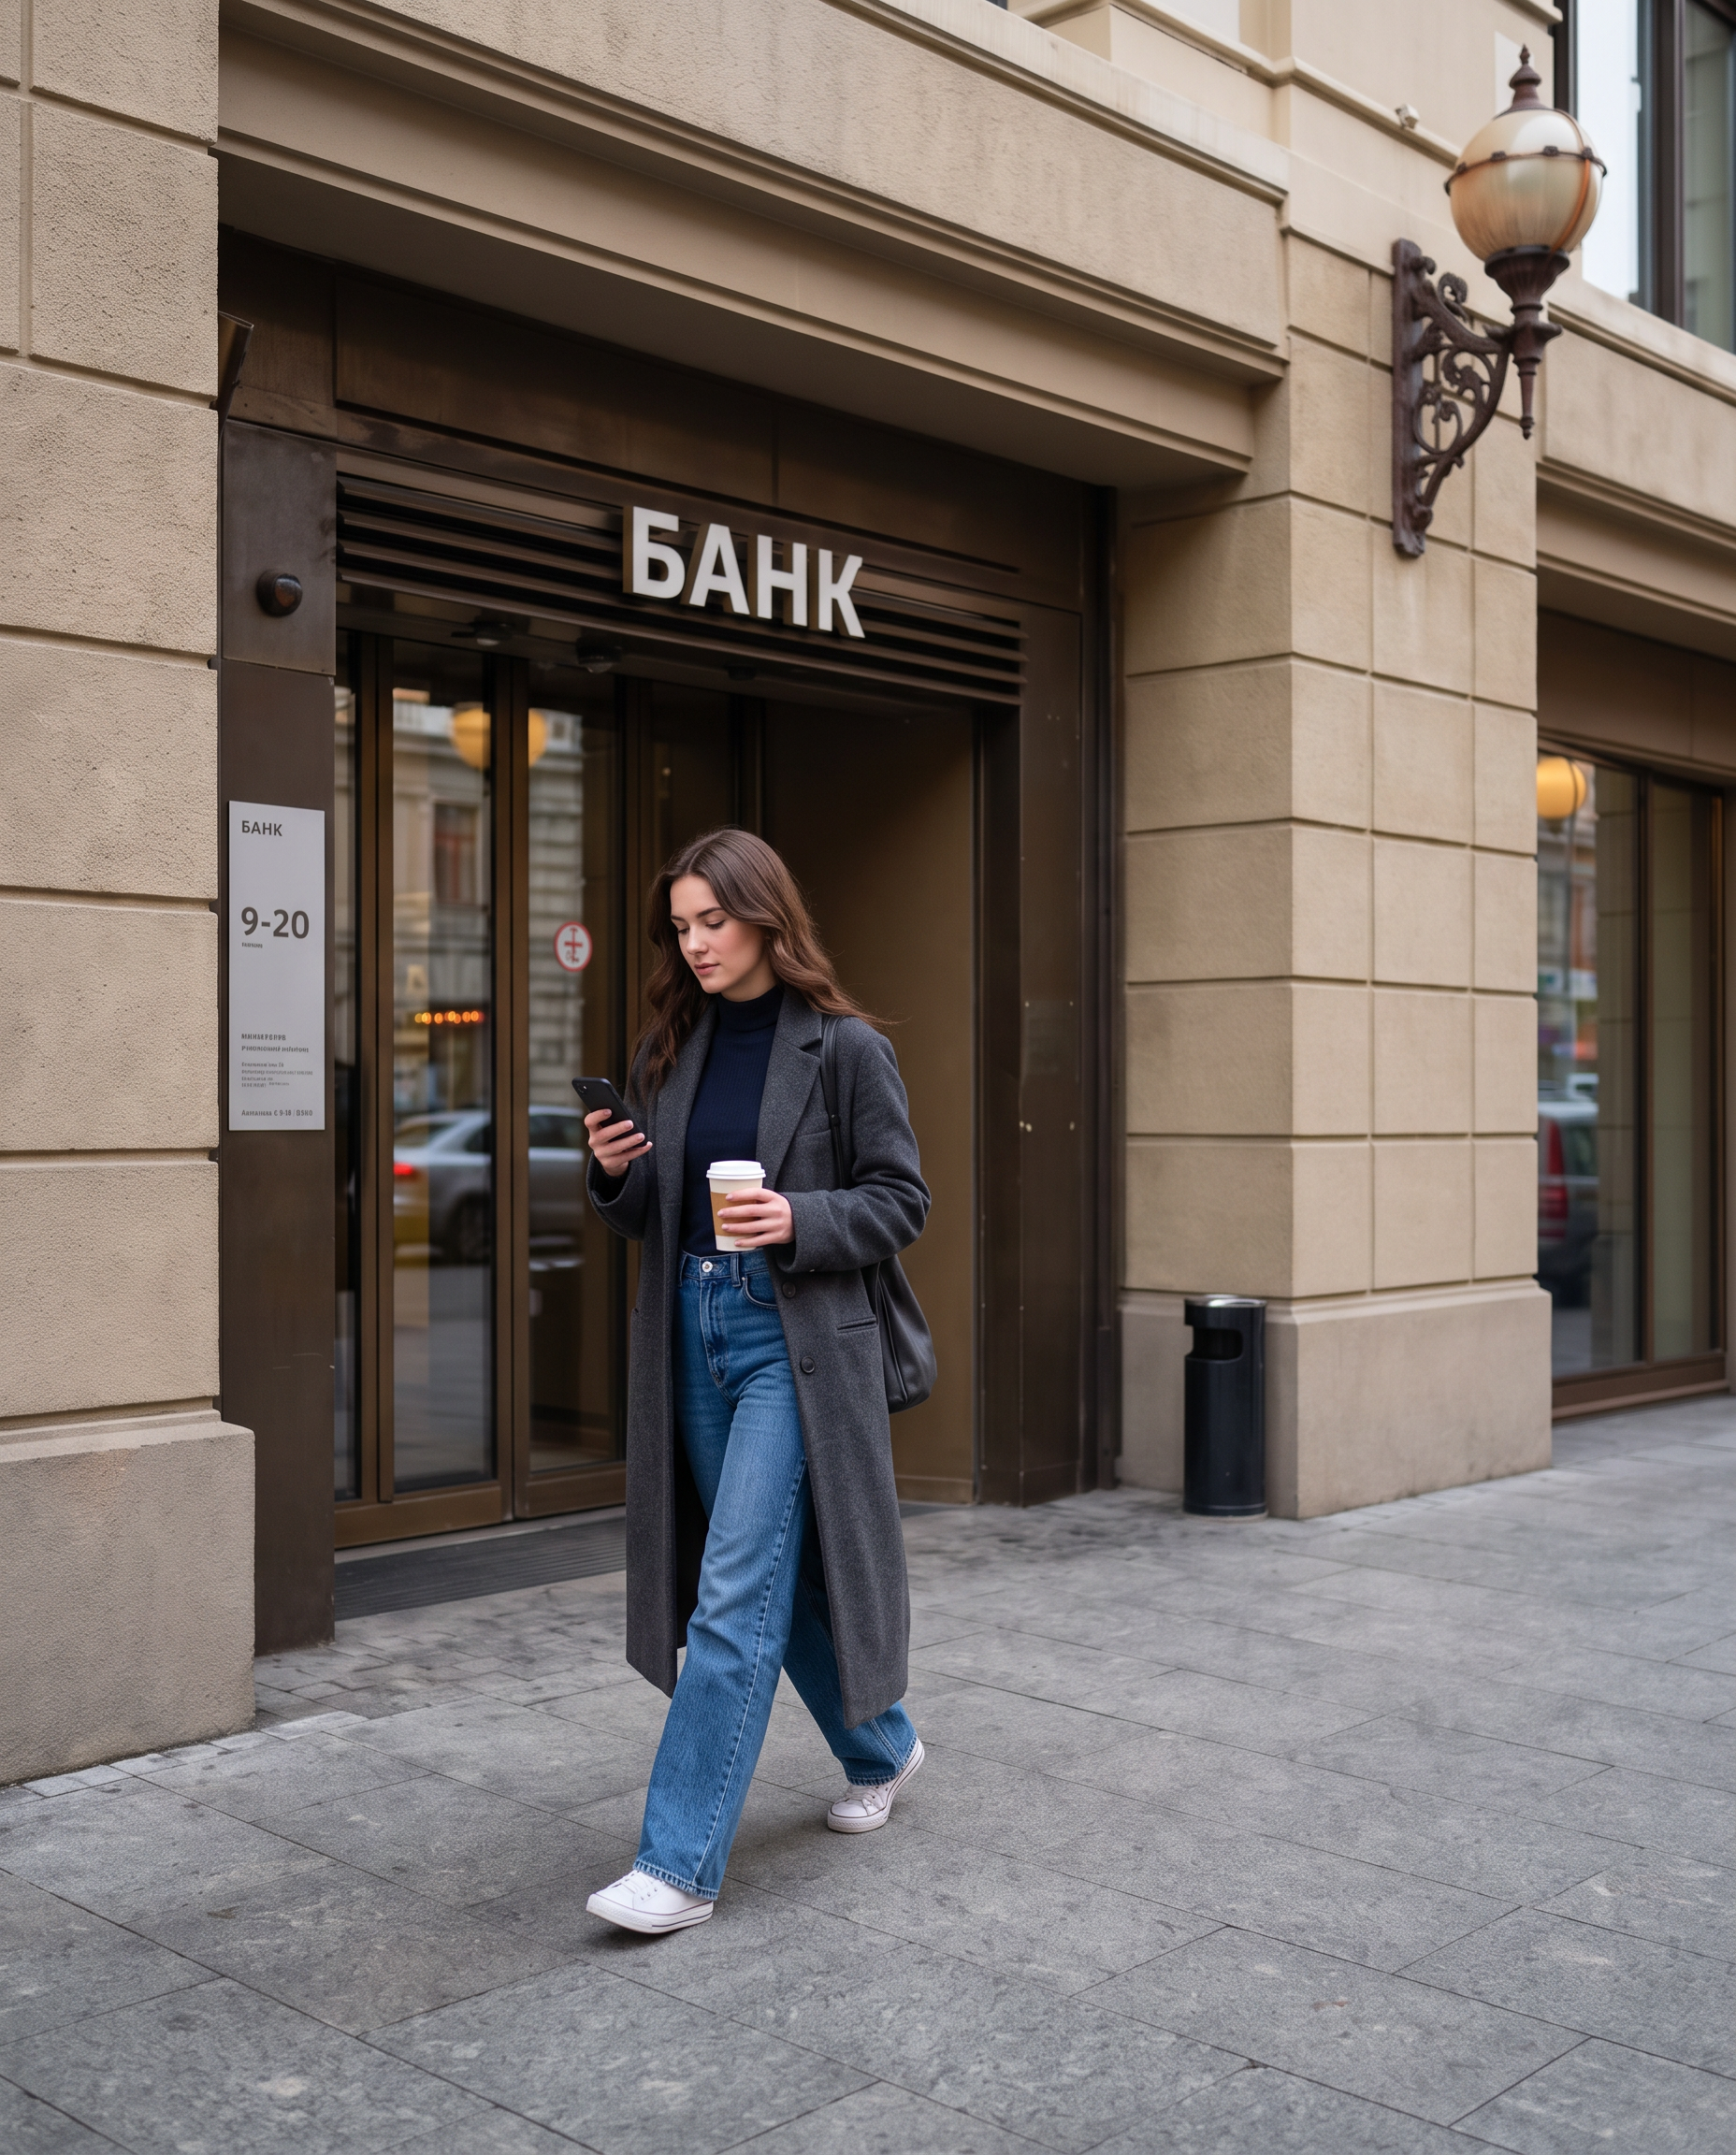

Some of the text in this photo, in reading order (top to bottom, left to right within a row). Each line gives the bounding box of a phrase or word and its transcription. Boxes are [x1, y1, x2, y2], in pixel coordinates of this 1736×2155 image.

[632, 506, 865, 639] БАНК
[241, 820, 282, 837] БАНК
[240, 906, 310, 939] 9-20
